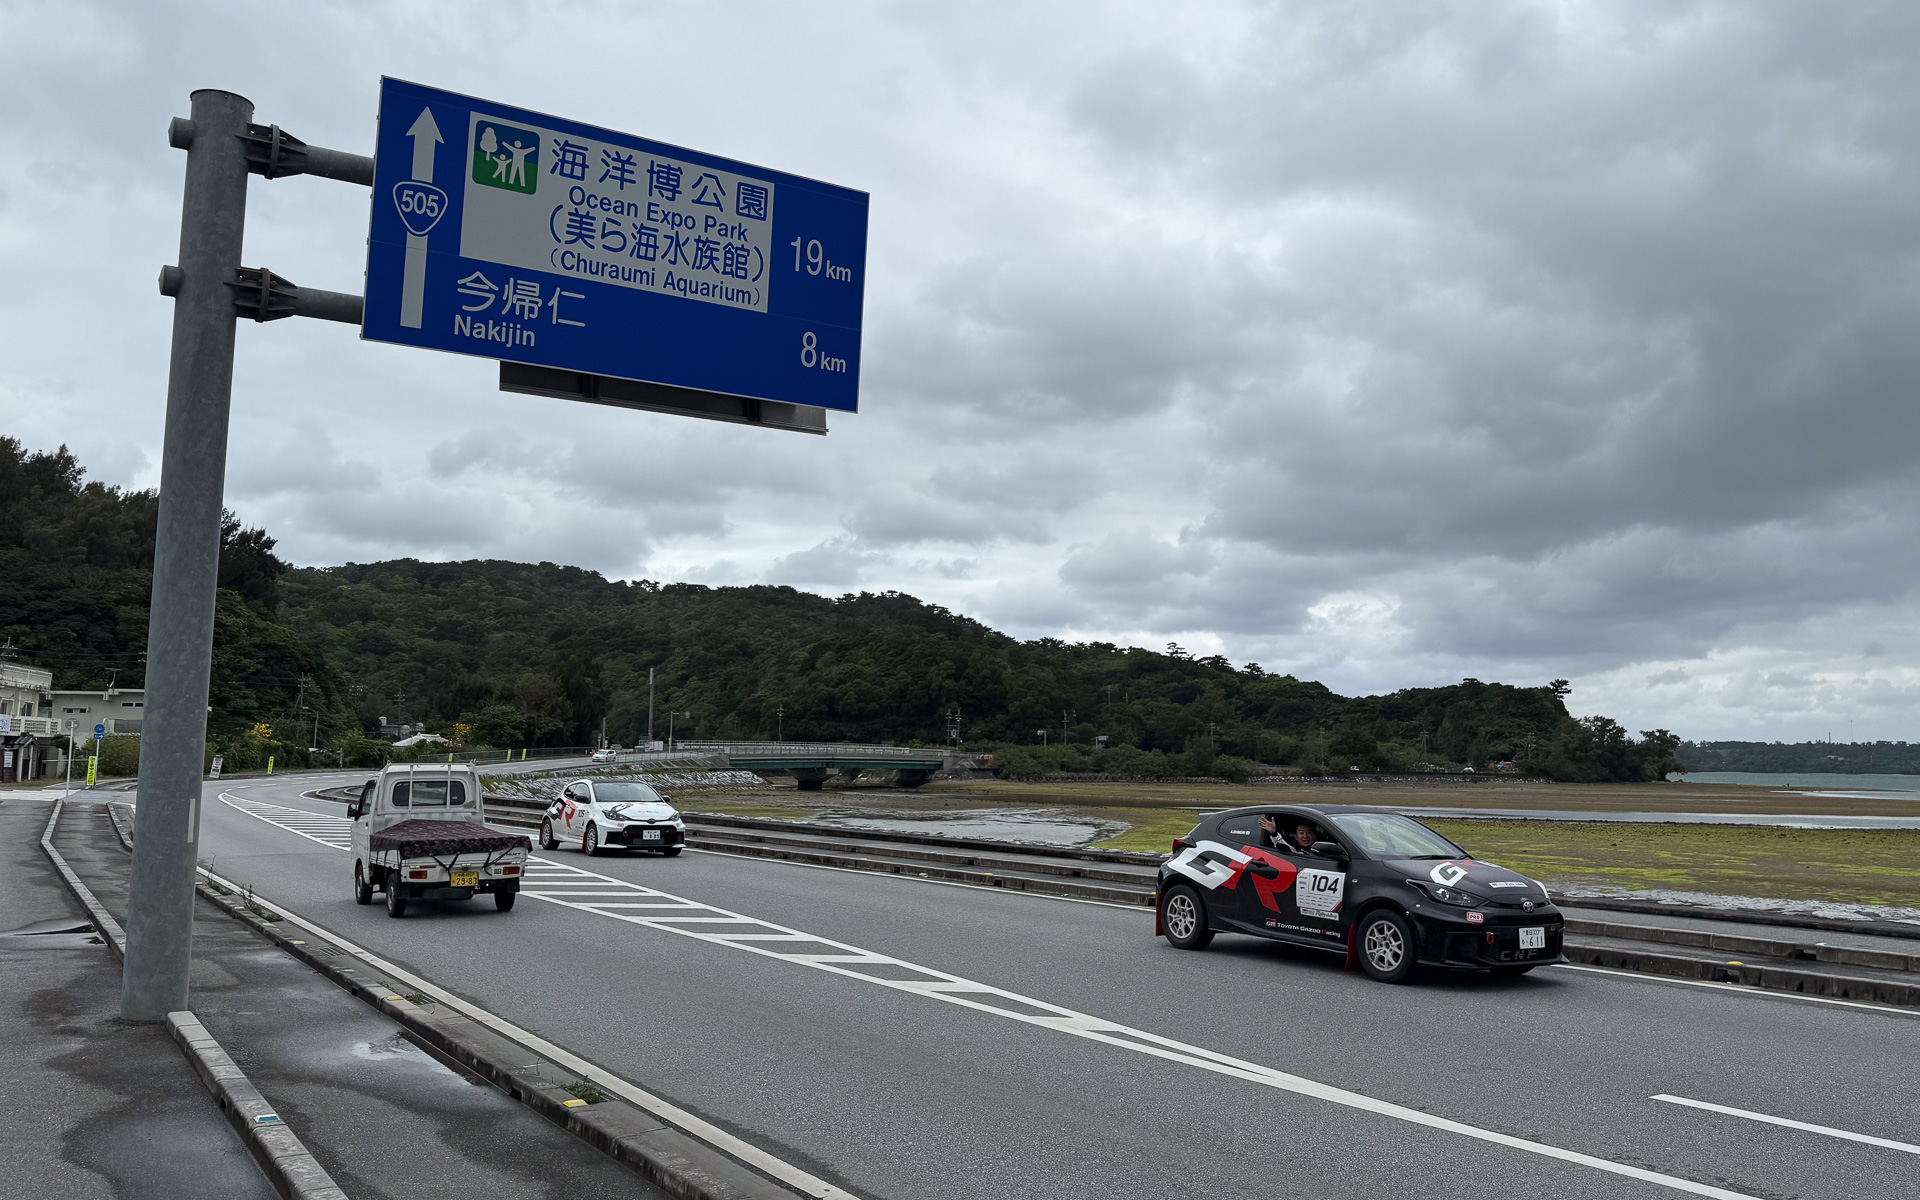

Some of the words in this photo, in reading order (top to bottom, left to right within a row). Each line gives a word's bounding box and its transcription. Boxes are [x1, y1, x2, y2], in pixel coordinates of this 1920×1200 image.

[401, 189, 439, 218] 505
[550, 138, 769, 222] 海洋博公園
[568, 185, 639, 218] Ocean
[646, 203, 697, 231] Expo
[704, 214, 749, 242] Park
[549, 203, 764, 283] (美ら海水族館)
[457, 270, 586, 328] 今帰仁
[550, 247, 656, 287] (Churaumi
[663, 270, 761, 306] Aquarium)
[453, 314, 536, 348] Nakijin
[1167, 840, 1297, 914] GR
[1311, 874, 1340, 894] 104
